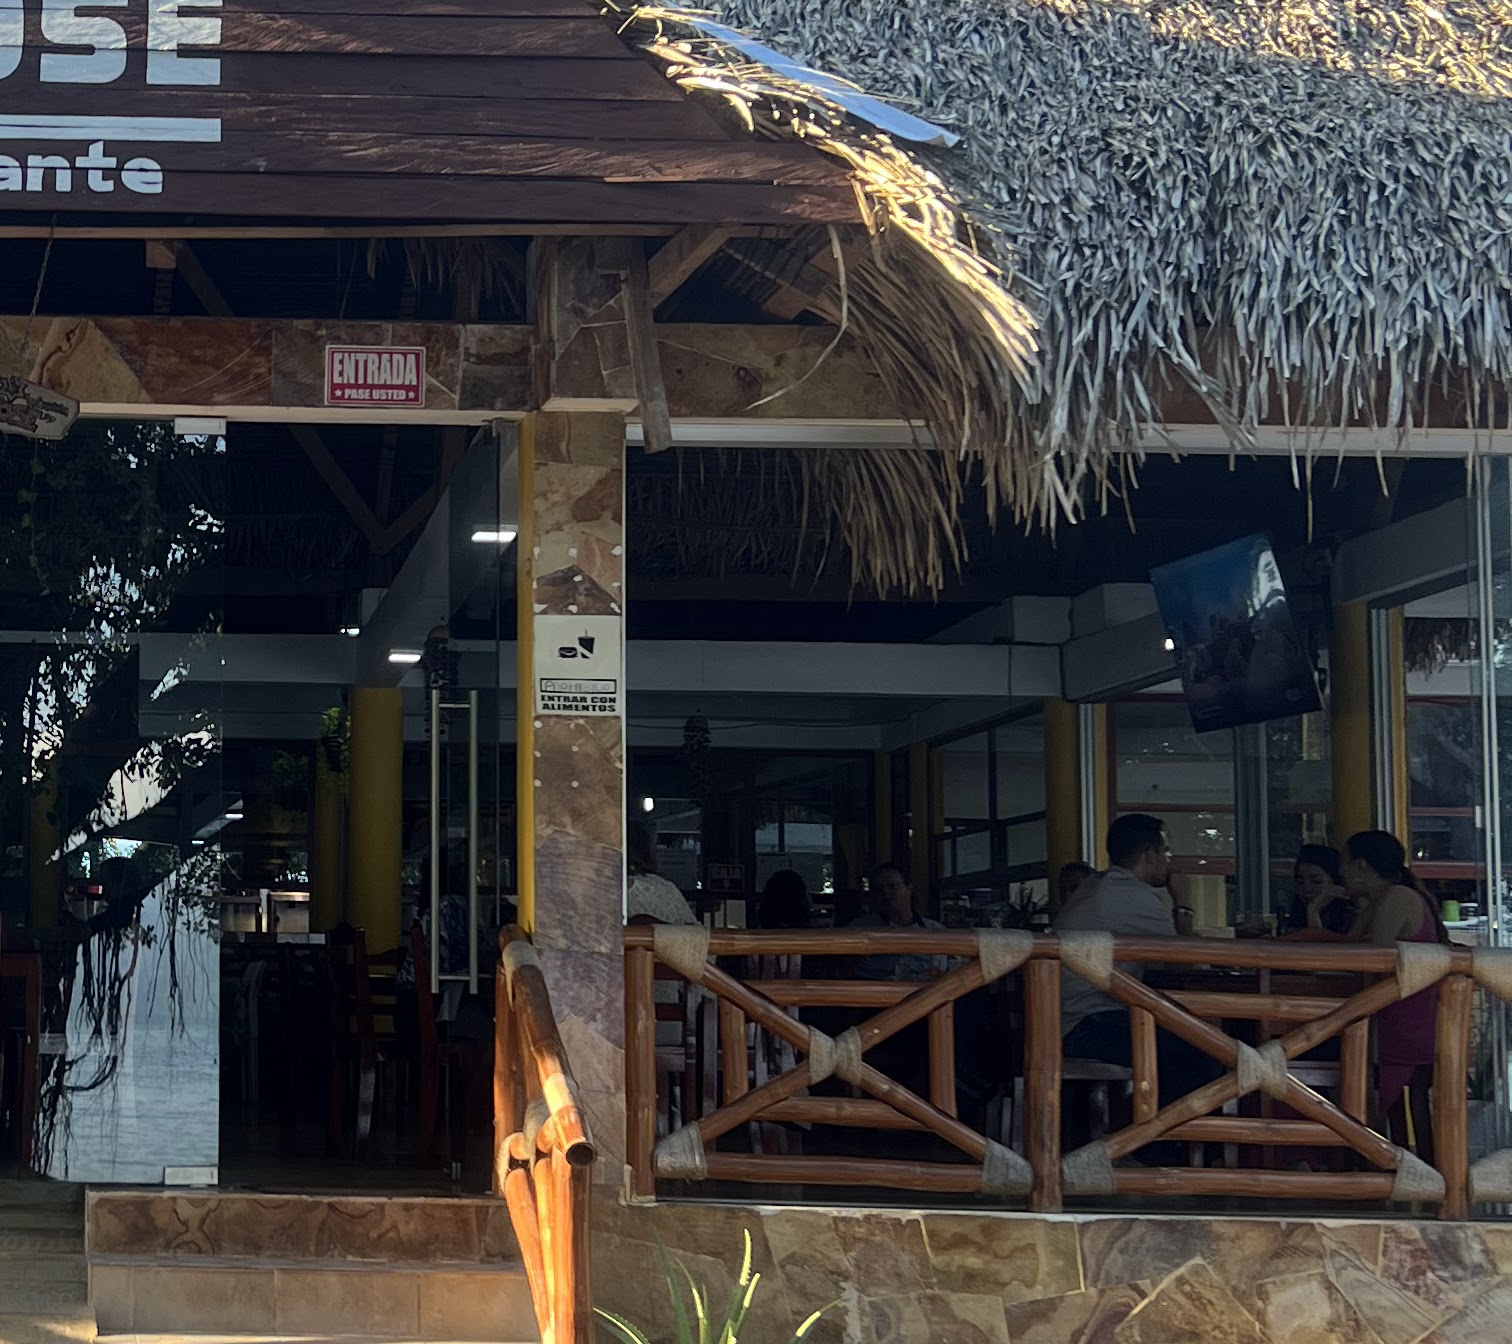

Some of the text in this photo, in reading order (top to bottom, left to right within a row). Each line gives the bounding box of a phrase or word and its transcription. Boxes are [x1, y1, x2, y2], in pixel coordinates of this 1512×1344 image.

[333, 352, 417, 385] ENTRADA
[344, 388, 407, 401] PASE USTED
[541, 695, 616, 704] ENTRAR CON
[542, 703, 616, 712] ALIMENTOS
